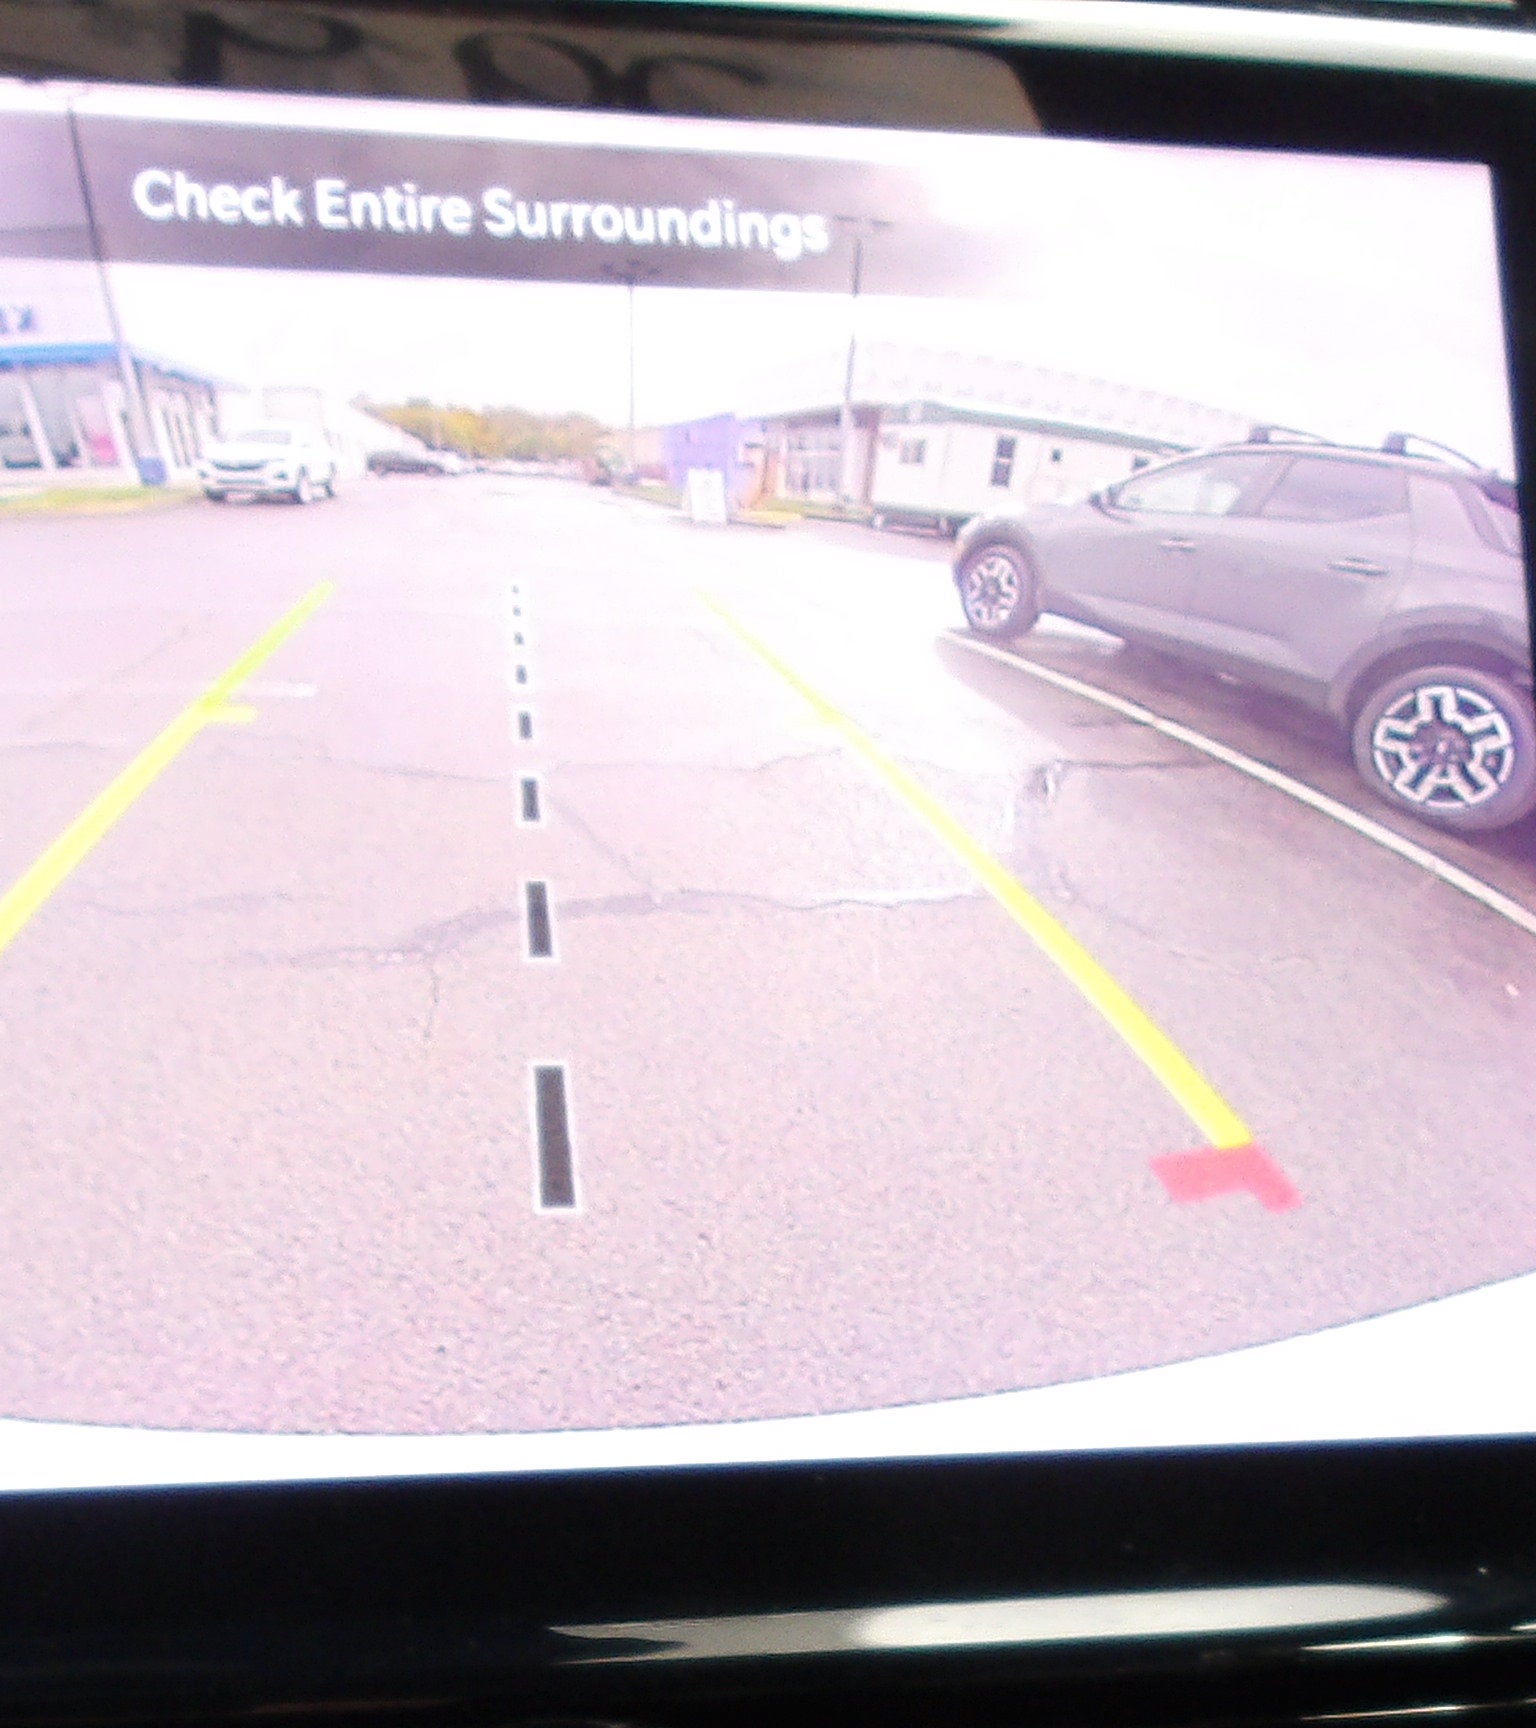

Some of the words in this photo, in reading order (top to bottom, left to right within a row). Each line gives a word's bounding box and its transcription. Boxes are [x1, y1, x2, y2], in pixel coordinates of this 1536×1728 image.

[131, 167, 303, 229] Check
[313, 177, 473, 236] Entire
[483, 187, 831, 262] Surroundings
